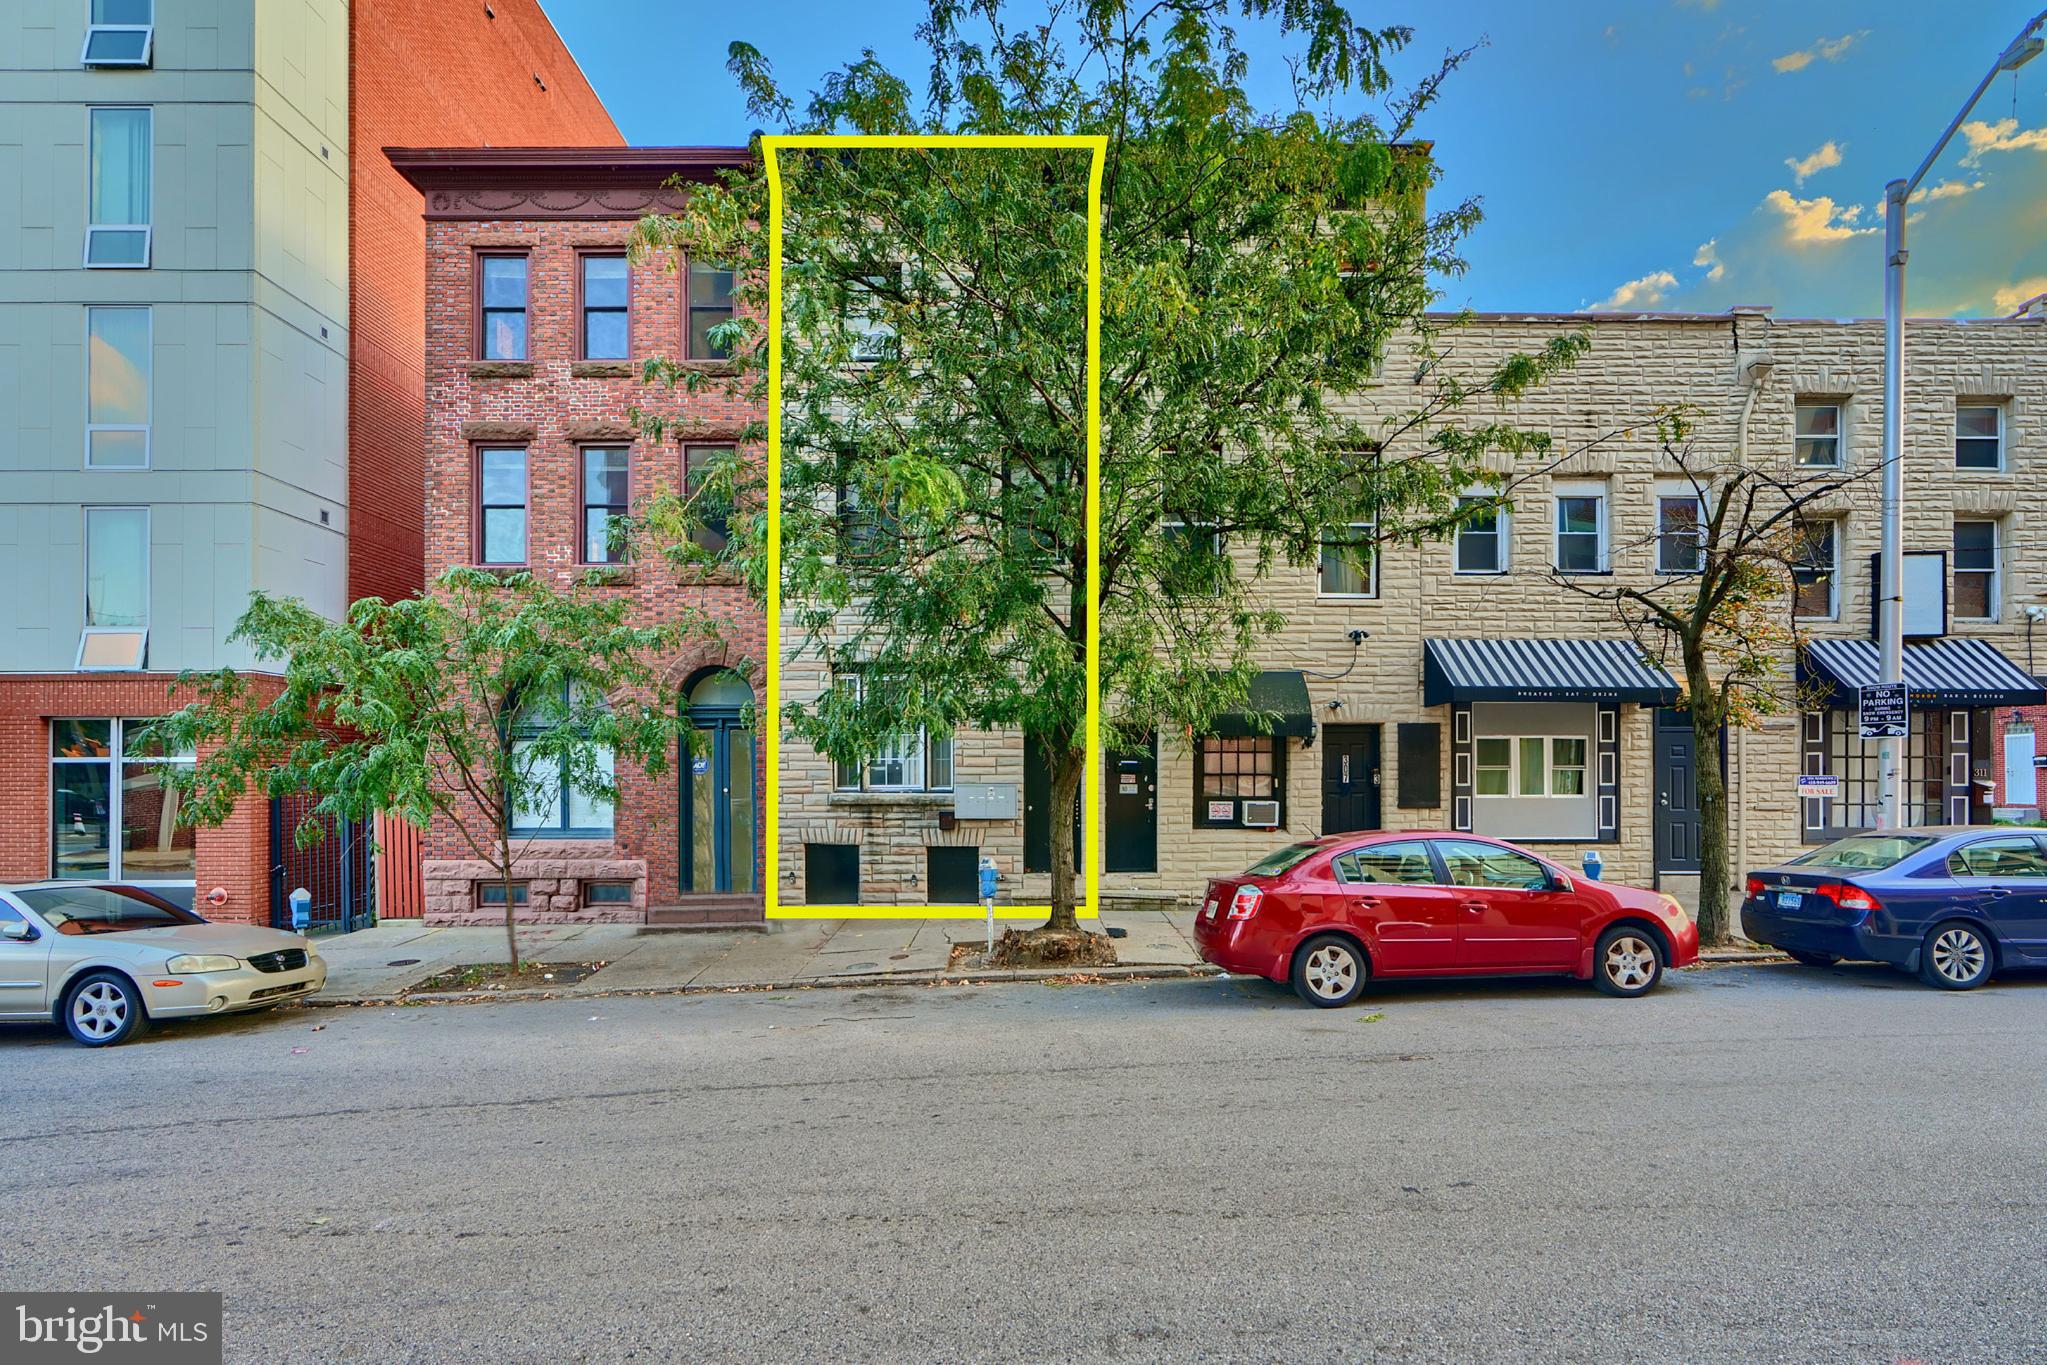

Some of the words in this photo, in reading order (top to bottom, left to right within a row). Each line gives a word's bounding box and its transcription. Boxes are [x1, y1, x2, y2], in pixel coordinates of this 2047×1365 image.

[1875, 690, 1891, 698] NO
[1862, 697, 1904, 707] PARKING
[1974, 768, 1987, 777] 311
